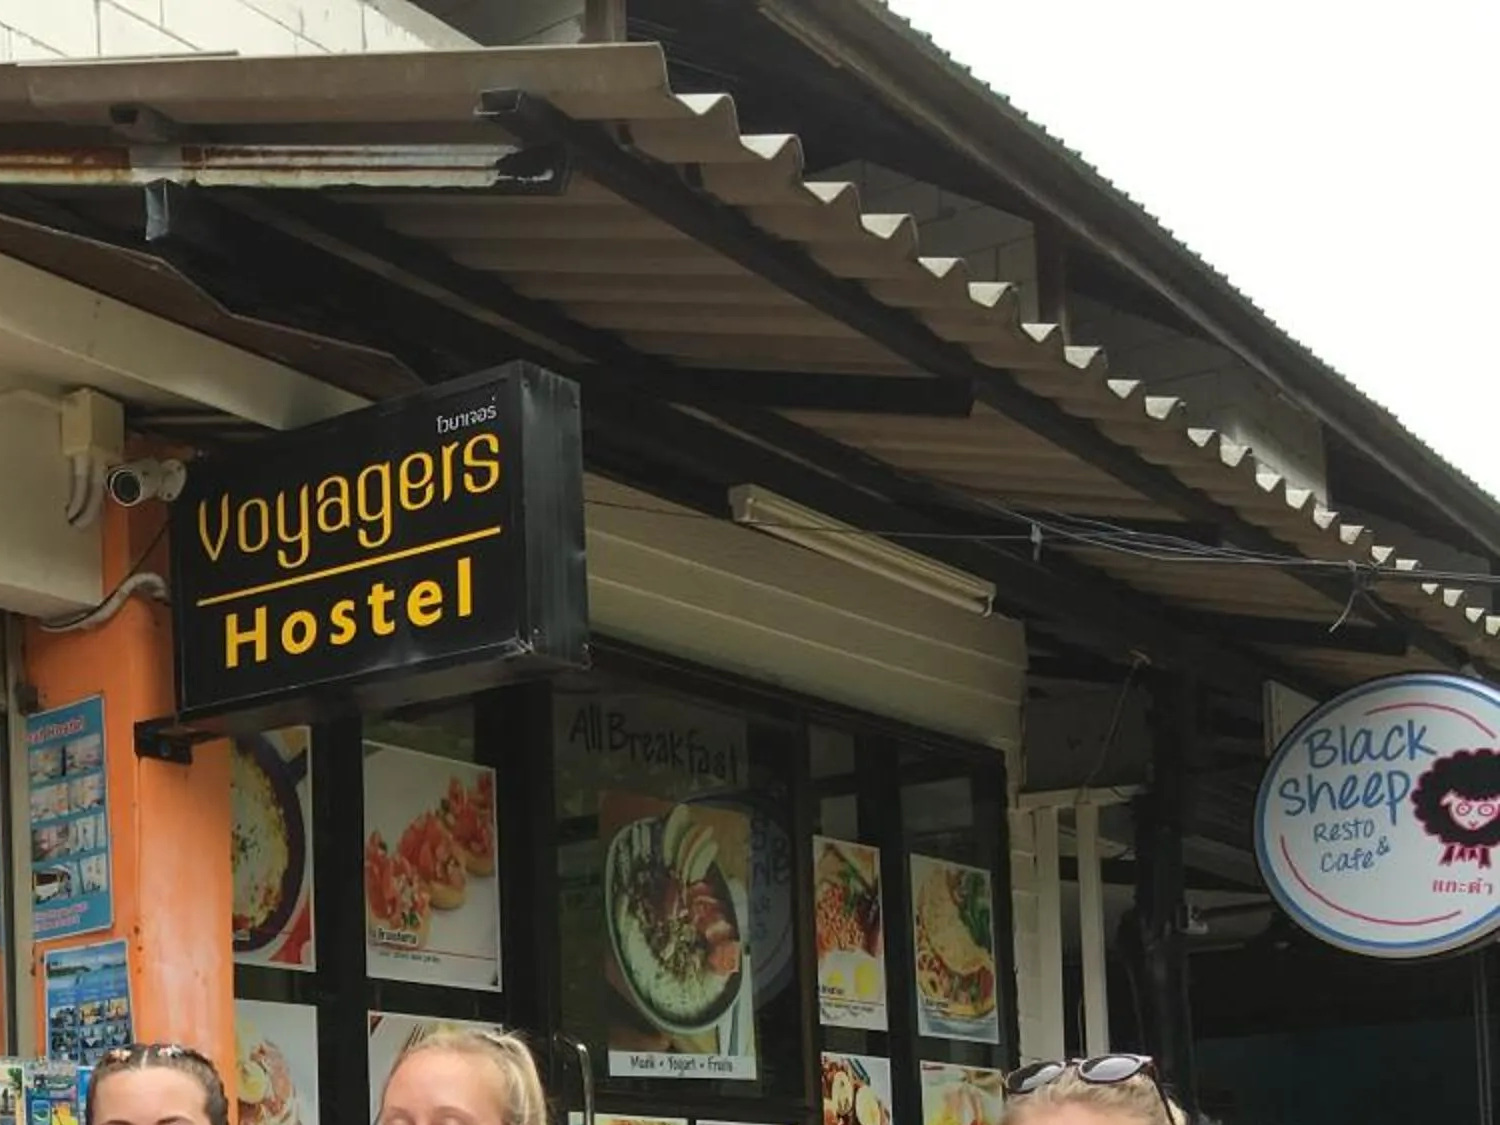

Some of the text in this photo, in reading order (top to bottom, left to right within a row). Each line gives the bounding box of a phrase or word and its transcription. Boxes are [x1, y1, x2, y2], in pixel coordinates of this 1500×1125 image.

[199, 432, 500, 569] Voyagers
[225, 557, 473, 669] Hostel
[569, 702, 603, 753] All
[1303, 719, 1437, 768] Black
[1313, 818, 1375, 843] Resto
